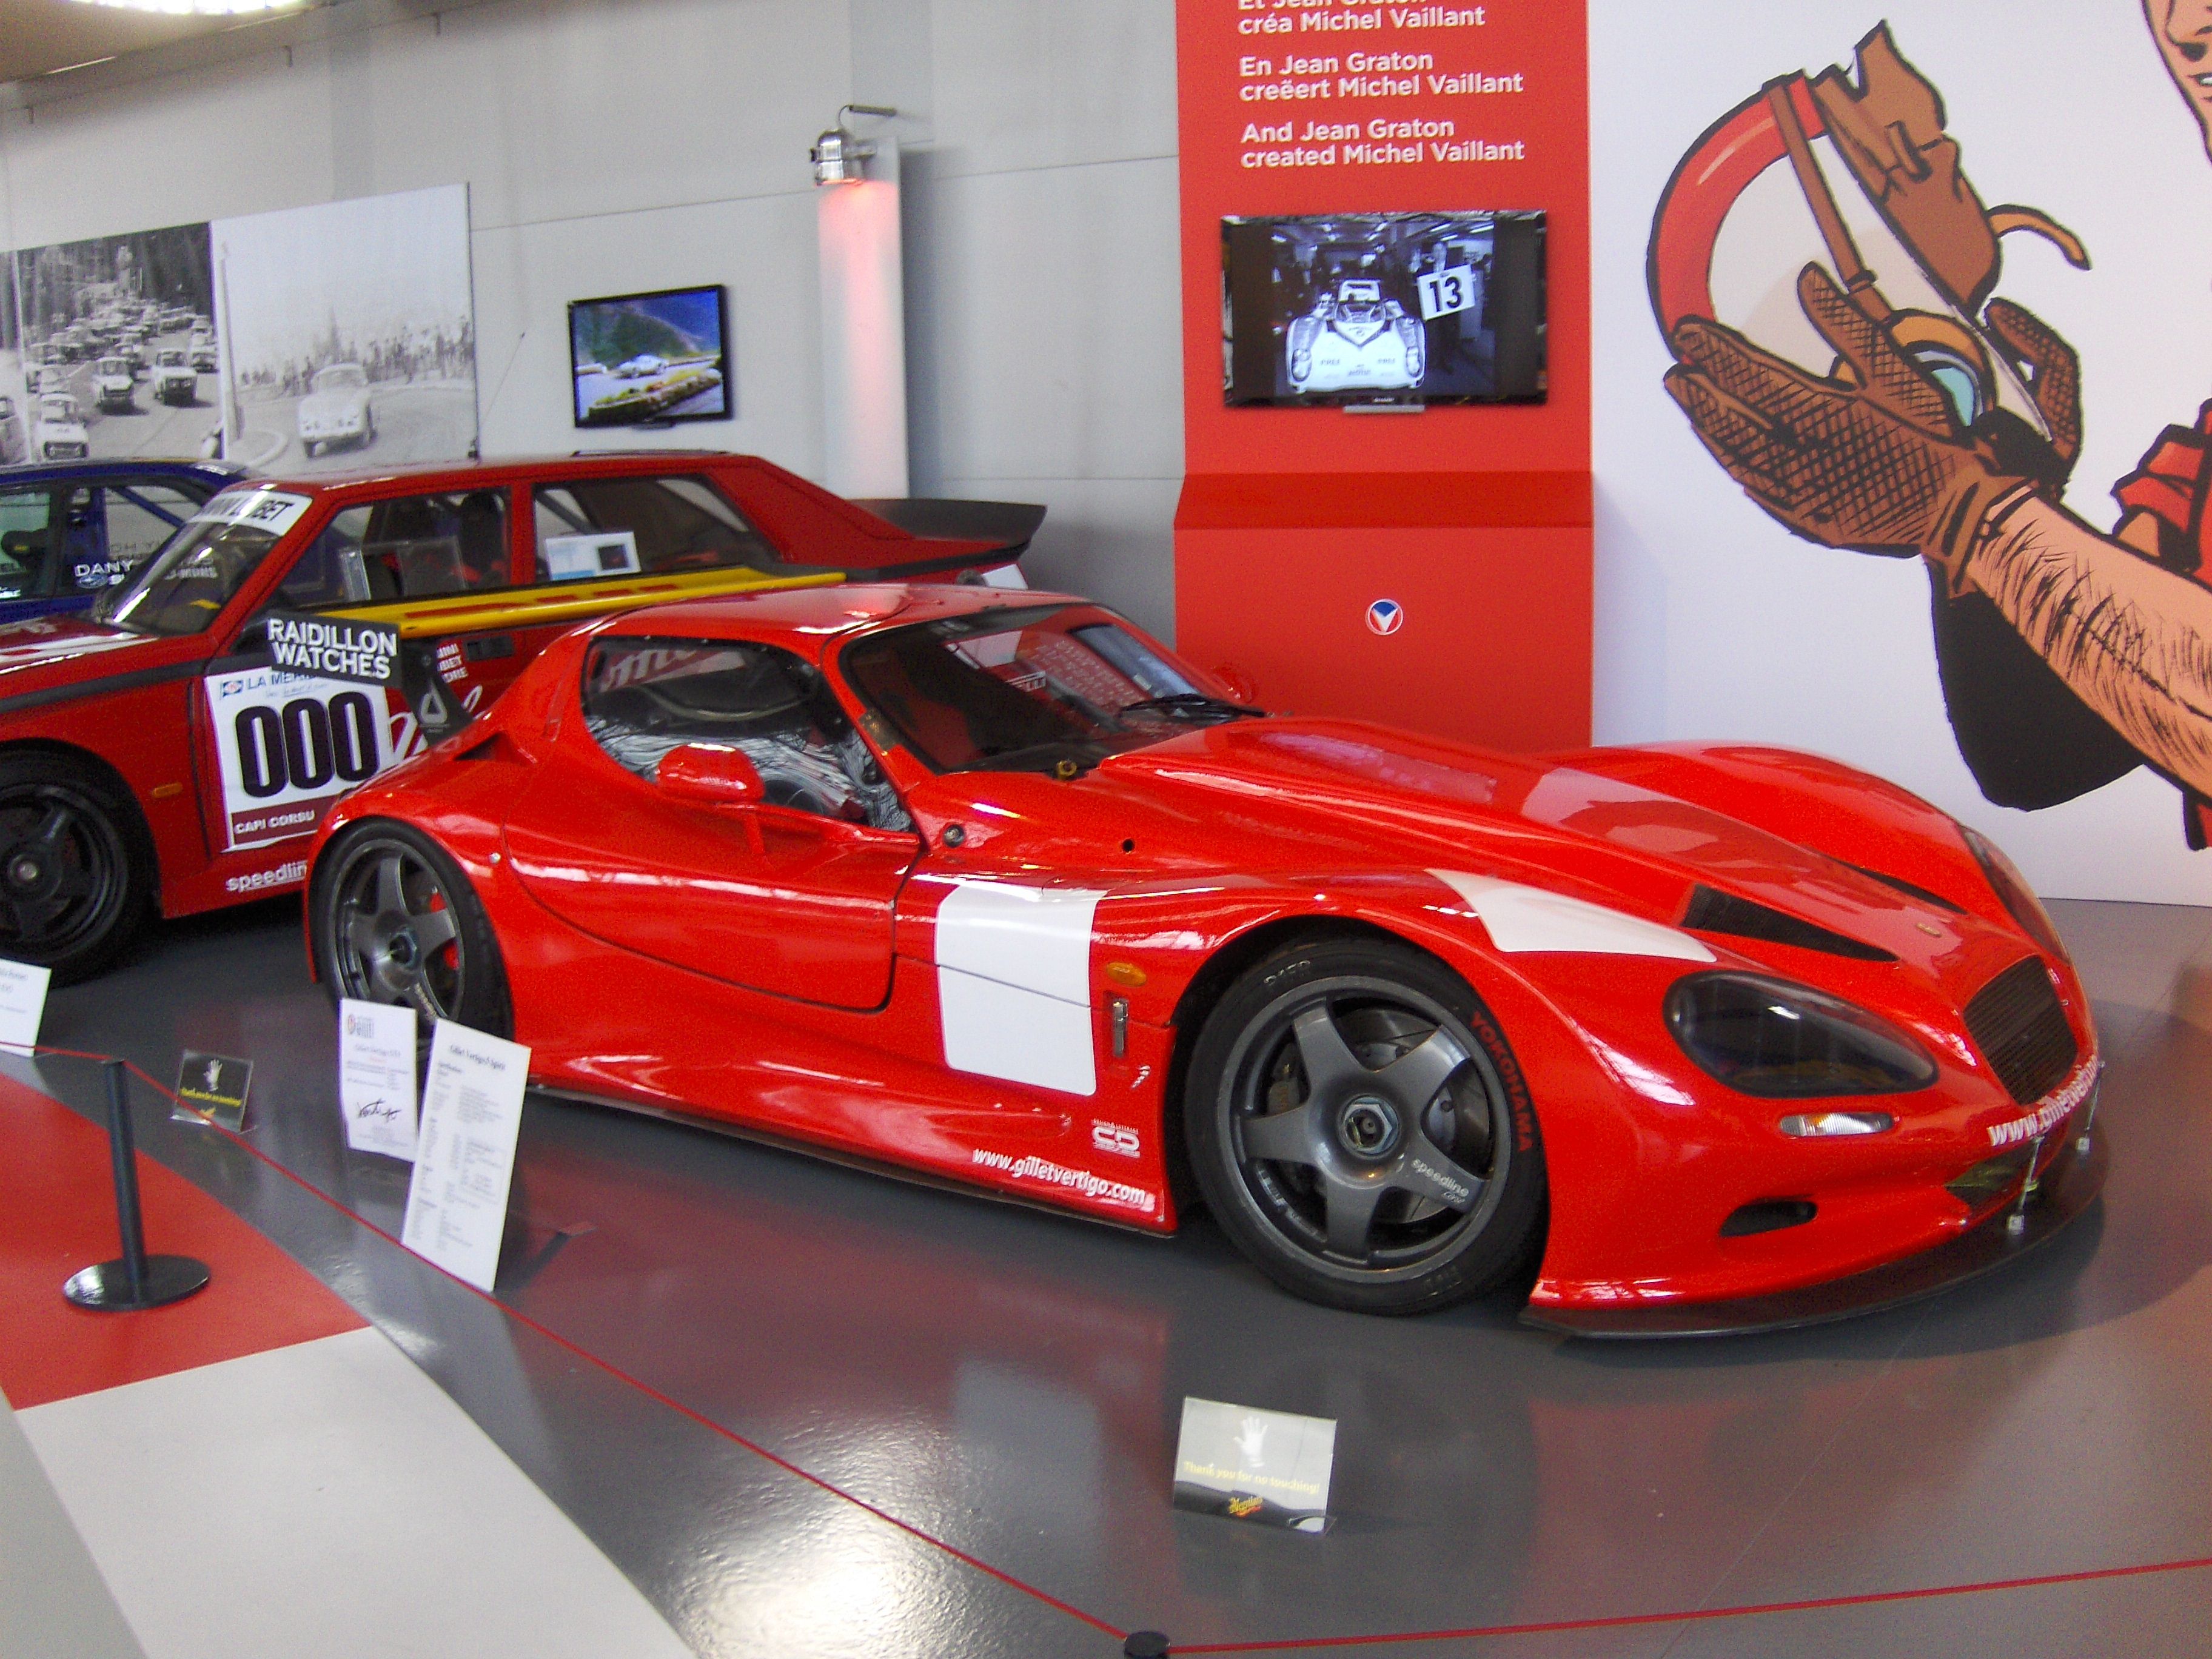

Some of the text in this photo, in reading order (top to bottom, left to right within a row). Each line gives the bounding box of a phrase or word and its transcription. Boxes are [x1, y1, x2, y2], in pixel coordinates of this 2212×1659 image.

[1238, 6, 1486, 35] créa Michel Vaillant
[1239, 52, 1433, 77] En Jean Graton
[1239, 72, 1524, 101] creëert Michel Vaillant
[1240, 118, 1455, 144] And Jean Graton
[1241, 140, 1525, 169] created Michel Vaillant
[1429, 276, 1462, 312] 13
[74, 560, 133, 577] DANY
[267, 617, 398, 657] RAIDILLON
[270, 641, 392, 680] WATCHES
[235, 691, 381, 798] 000
[233, 810, 315, 835] CAPI CORSU
[226, 860, 307, 893] speedlin
[1471, 1010, 1533, 1153] YOKOHAMA
[972, 1148, 1146, 1205] www.gilletvertigo.com
[1412, 1159, 1469, 1198] speedline
[1184, 1460, 1215, 1476] Thank
